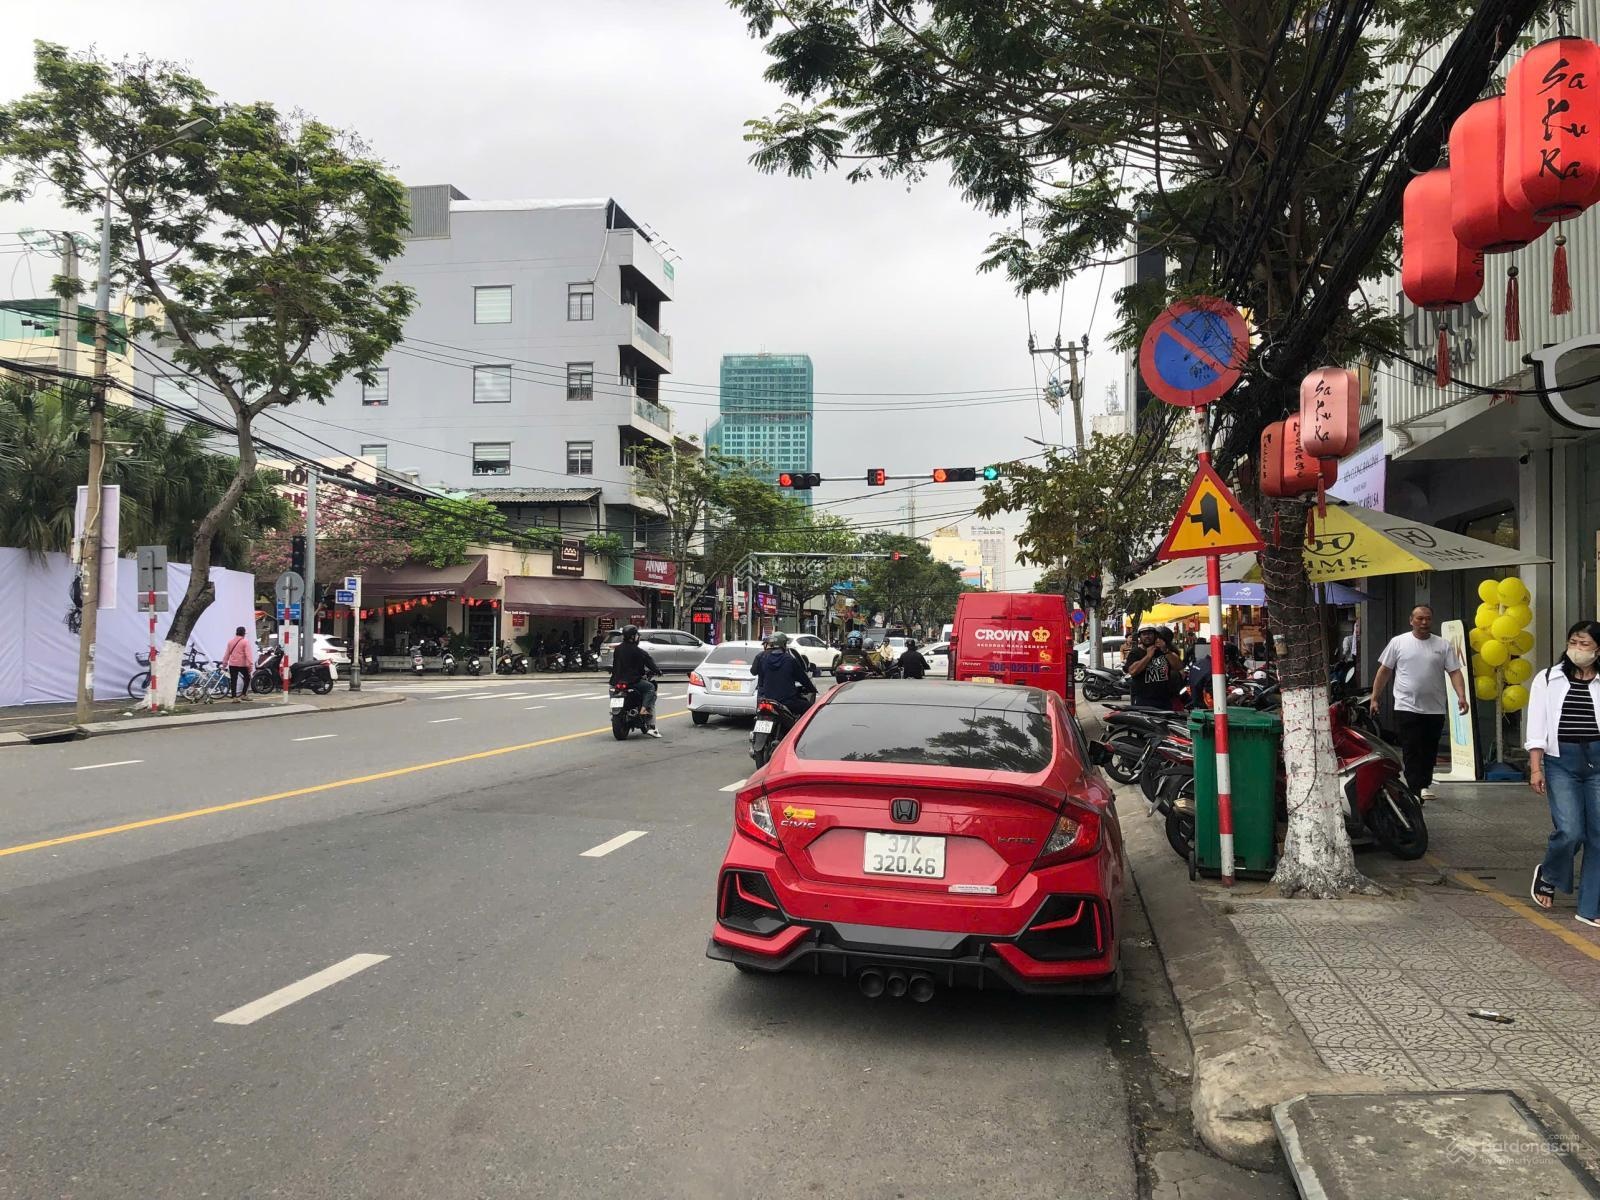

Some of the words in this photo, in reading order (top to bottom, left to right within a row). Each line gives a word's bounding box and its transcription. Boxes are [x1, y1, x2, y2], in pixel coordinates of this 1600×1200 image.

[1306, 564, 1368, 575] YEWEAR
[975, 628, 1029, 642] CROWN
[780, 820, 816, 829] CIVIC
[888, 835, 922, 855] 37K
[873, 854, 936, 875] 320.46
